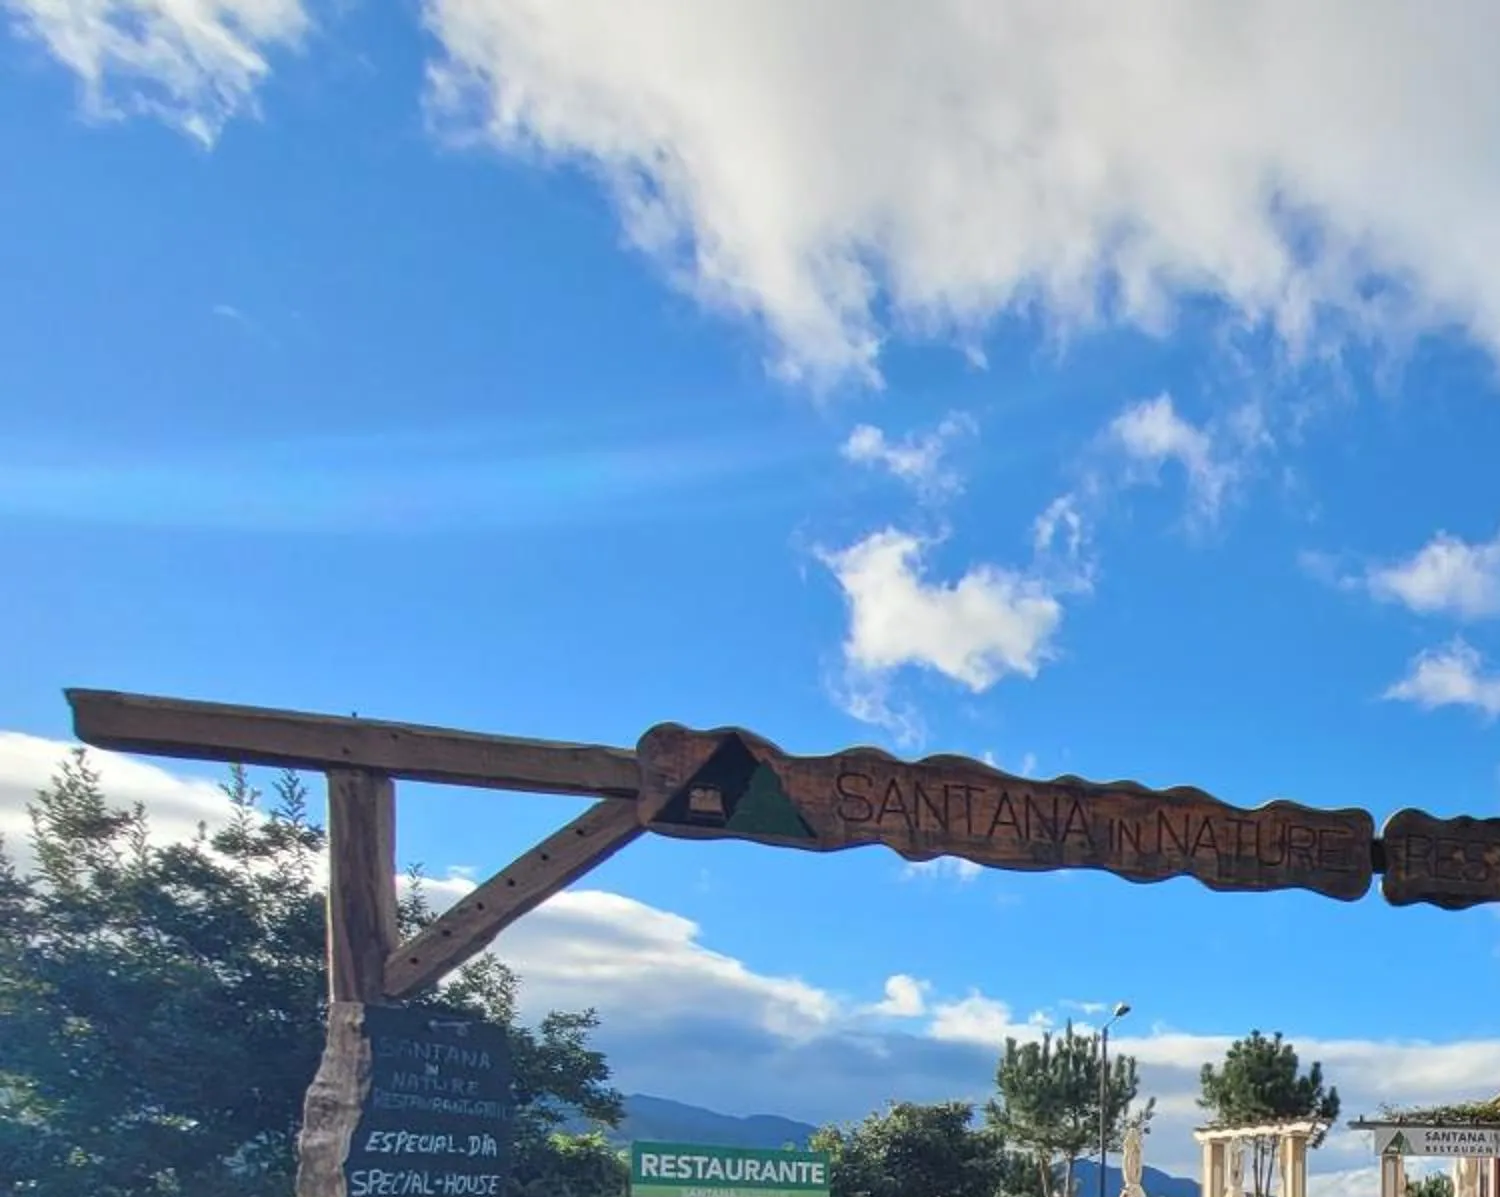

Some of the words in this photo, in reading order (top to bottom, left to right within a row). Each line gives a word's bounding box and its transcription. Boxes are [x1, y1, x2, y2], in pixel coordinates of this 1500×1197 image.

[835, 772, 1094, 846] SANTANA
[1108, 817, 1141, 858] IN
[1156, 809, 1351, 873] NATURE
[391, 1070, 479, 1097] NATURE
[1424, 1131, 1487, 1143] SANTANA
[1424, 1145, 1499, 1154] RESTAURANT
[640, 1153, 825, 1184] RESTAURANTE
